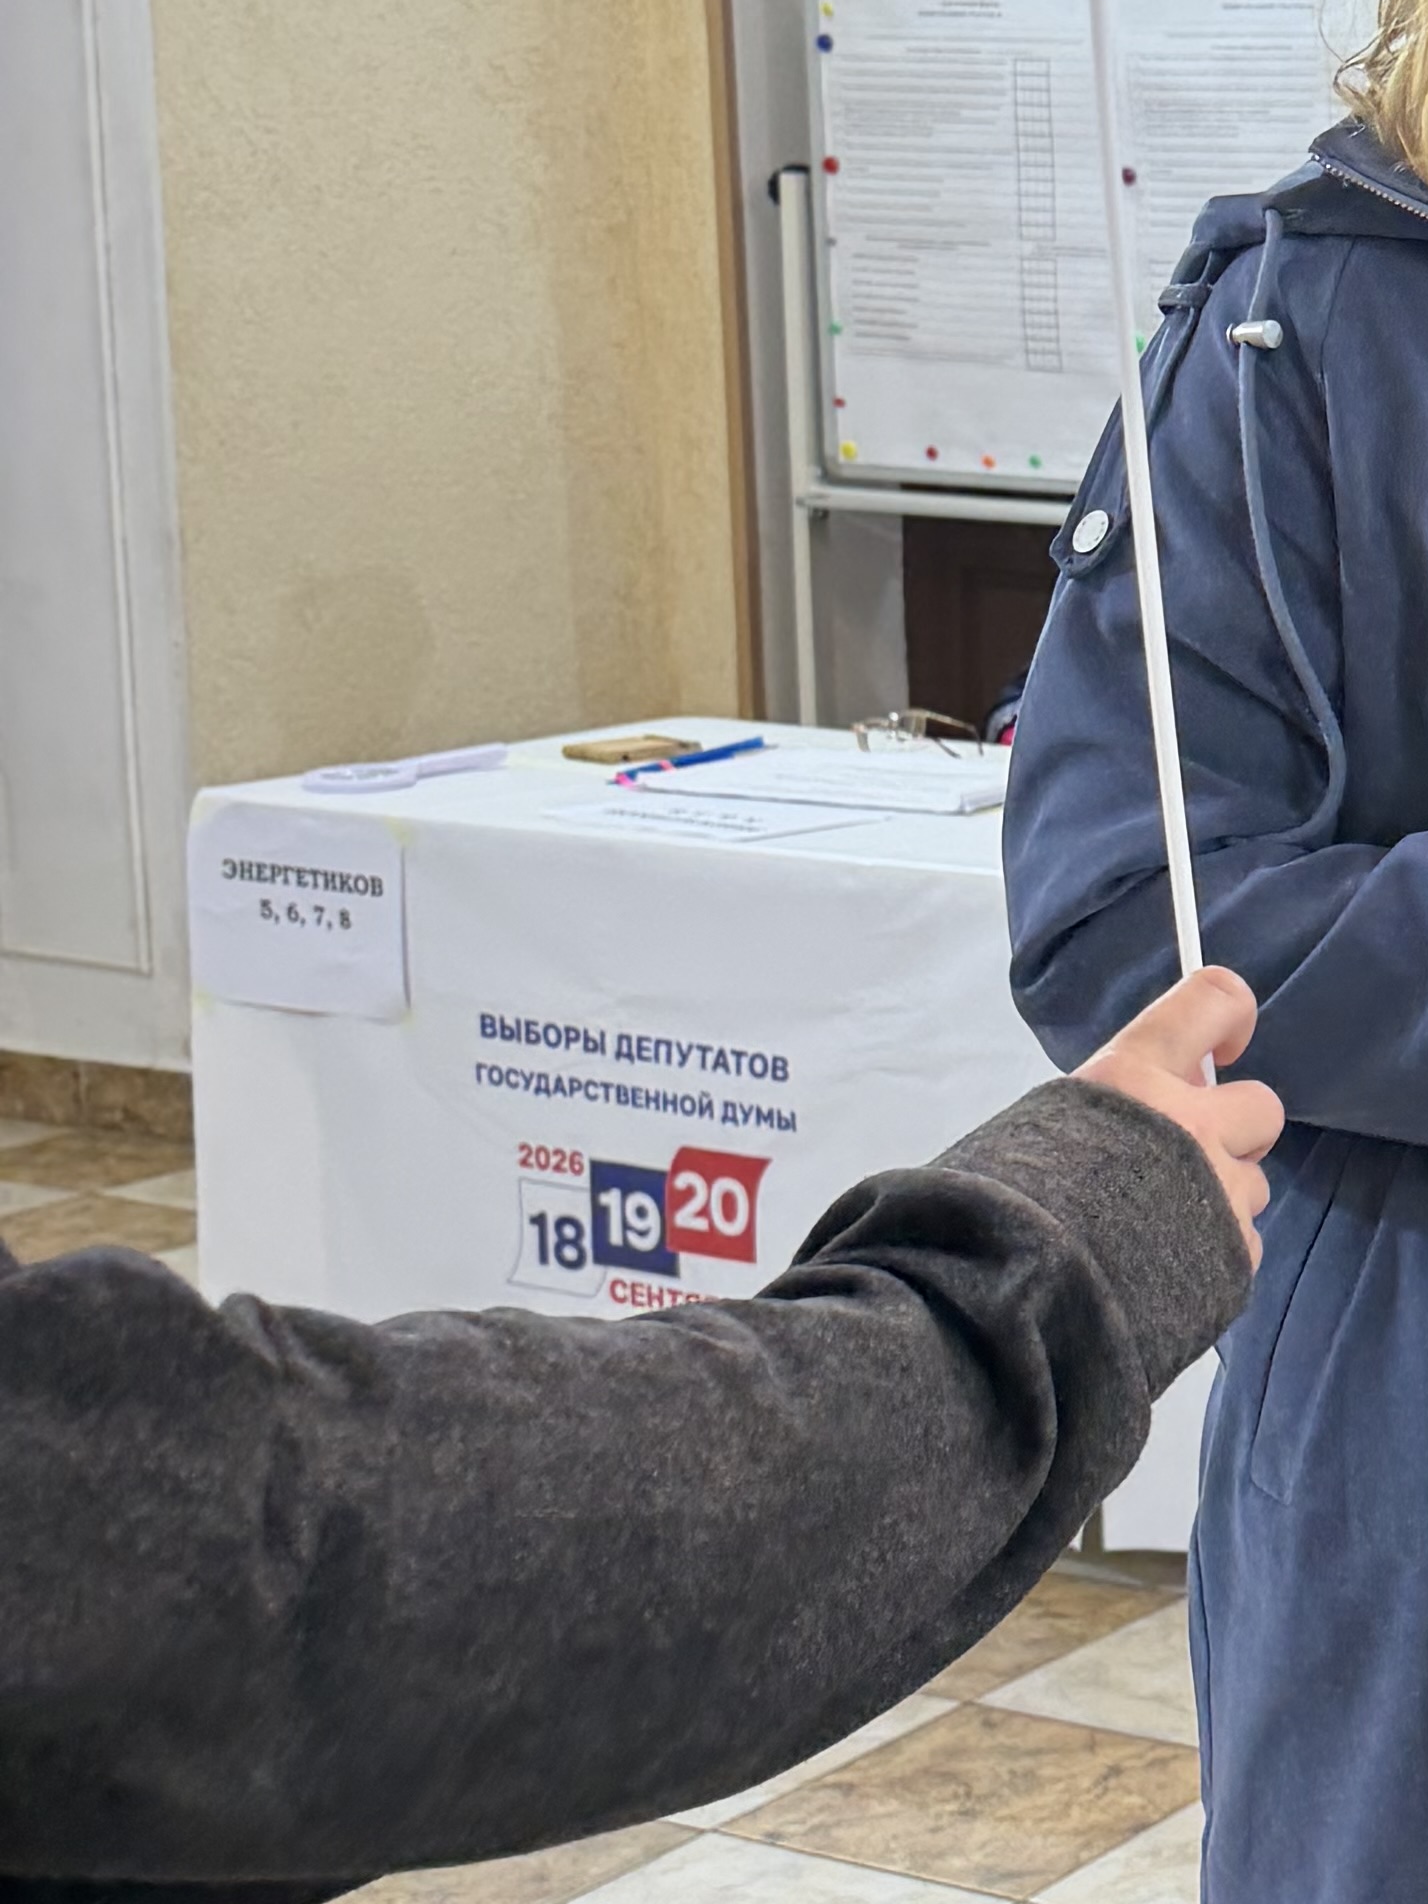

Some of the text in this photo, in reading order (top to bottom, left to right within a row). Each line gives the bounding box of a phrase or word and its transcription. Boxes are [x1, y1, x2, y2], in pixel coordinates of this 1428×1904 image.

[221, 857, 384, 898] ЭНЕРГЕТИКОВ
[259, 898, 352, 931] 5, 6, 7, 8
[479, 1013, 790, 1082] ВЫБОРЫ ДЕПУТАТОВ
[475, 1062, 797, 1132] ГОСУДАРСТВЕННОЙ ДУМЫ
[517, 1142, 585, 1176] 2026
[529, 1170, 750, 1270] 18 19 20
